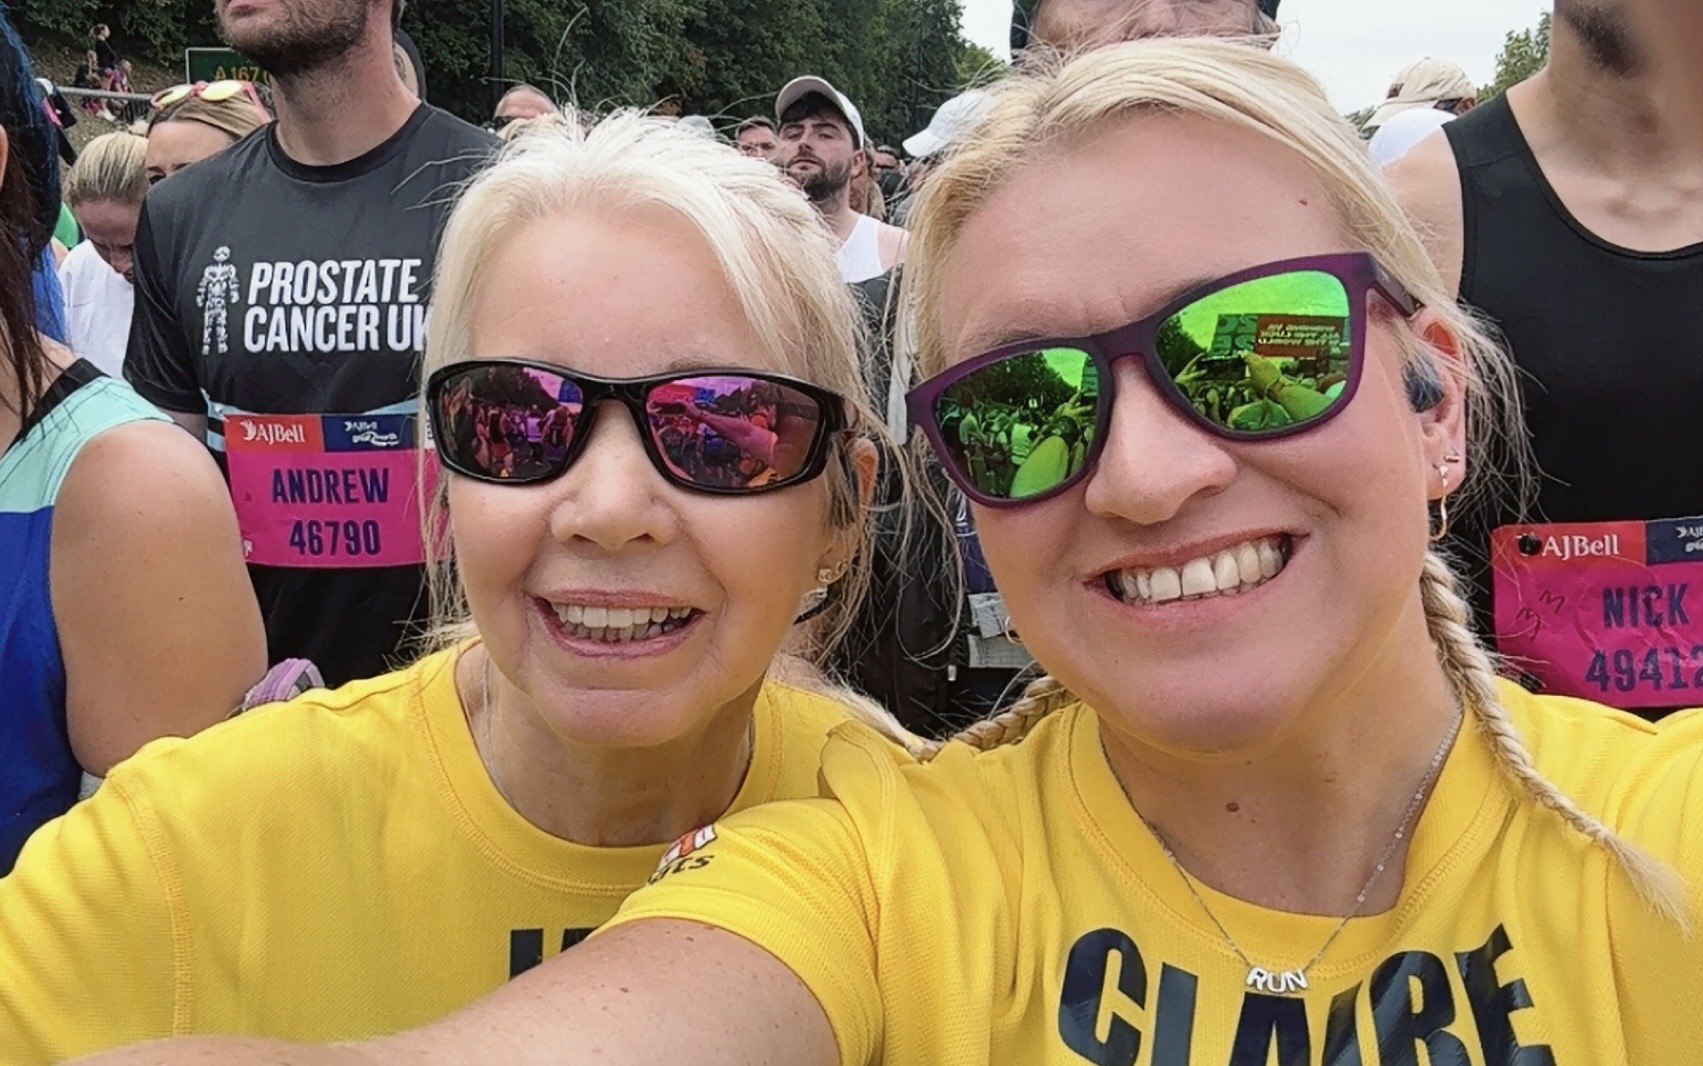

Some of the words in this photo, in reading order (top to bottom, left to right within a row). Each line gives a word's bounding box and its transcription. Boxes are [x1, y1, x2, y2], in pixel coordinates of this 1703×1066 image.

[247, 259, 421, 305] PROSTATE
[244, 304, 380, 352] CANCER
[271, 468, 389, 504] ANDREW
[289, 520, 381, 556] 46790
[1603, 583, 1689, 629] NICK
[1246, 966, 1308, 993] RUN
